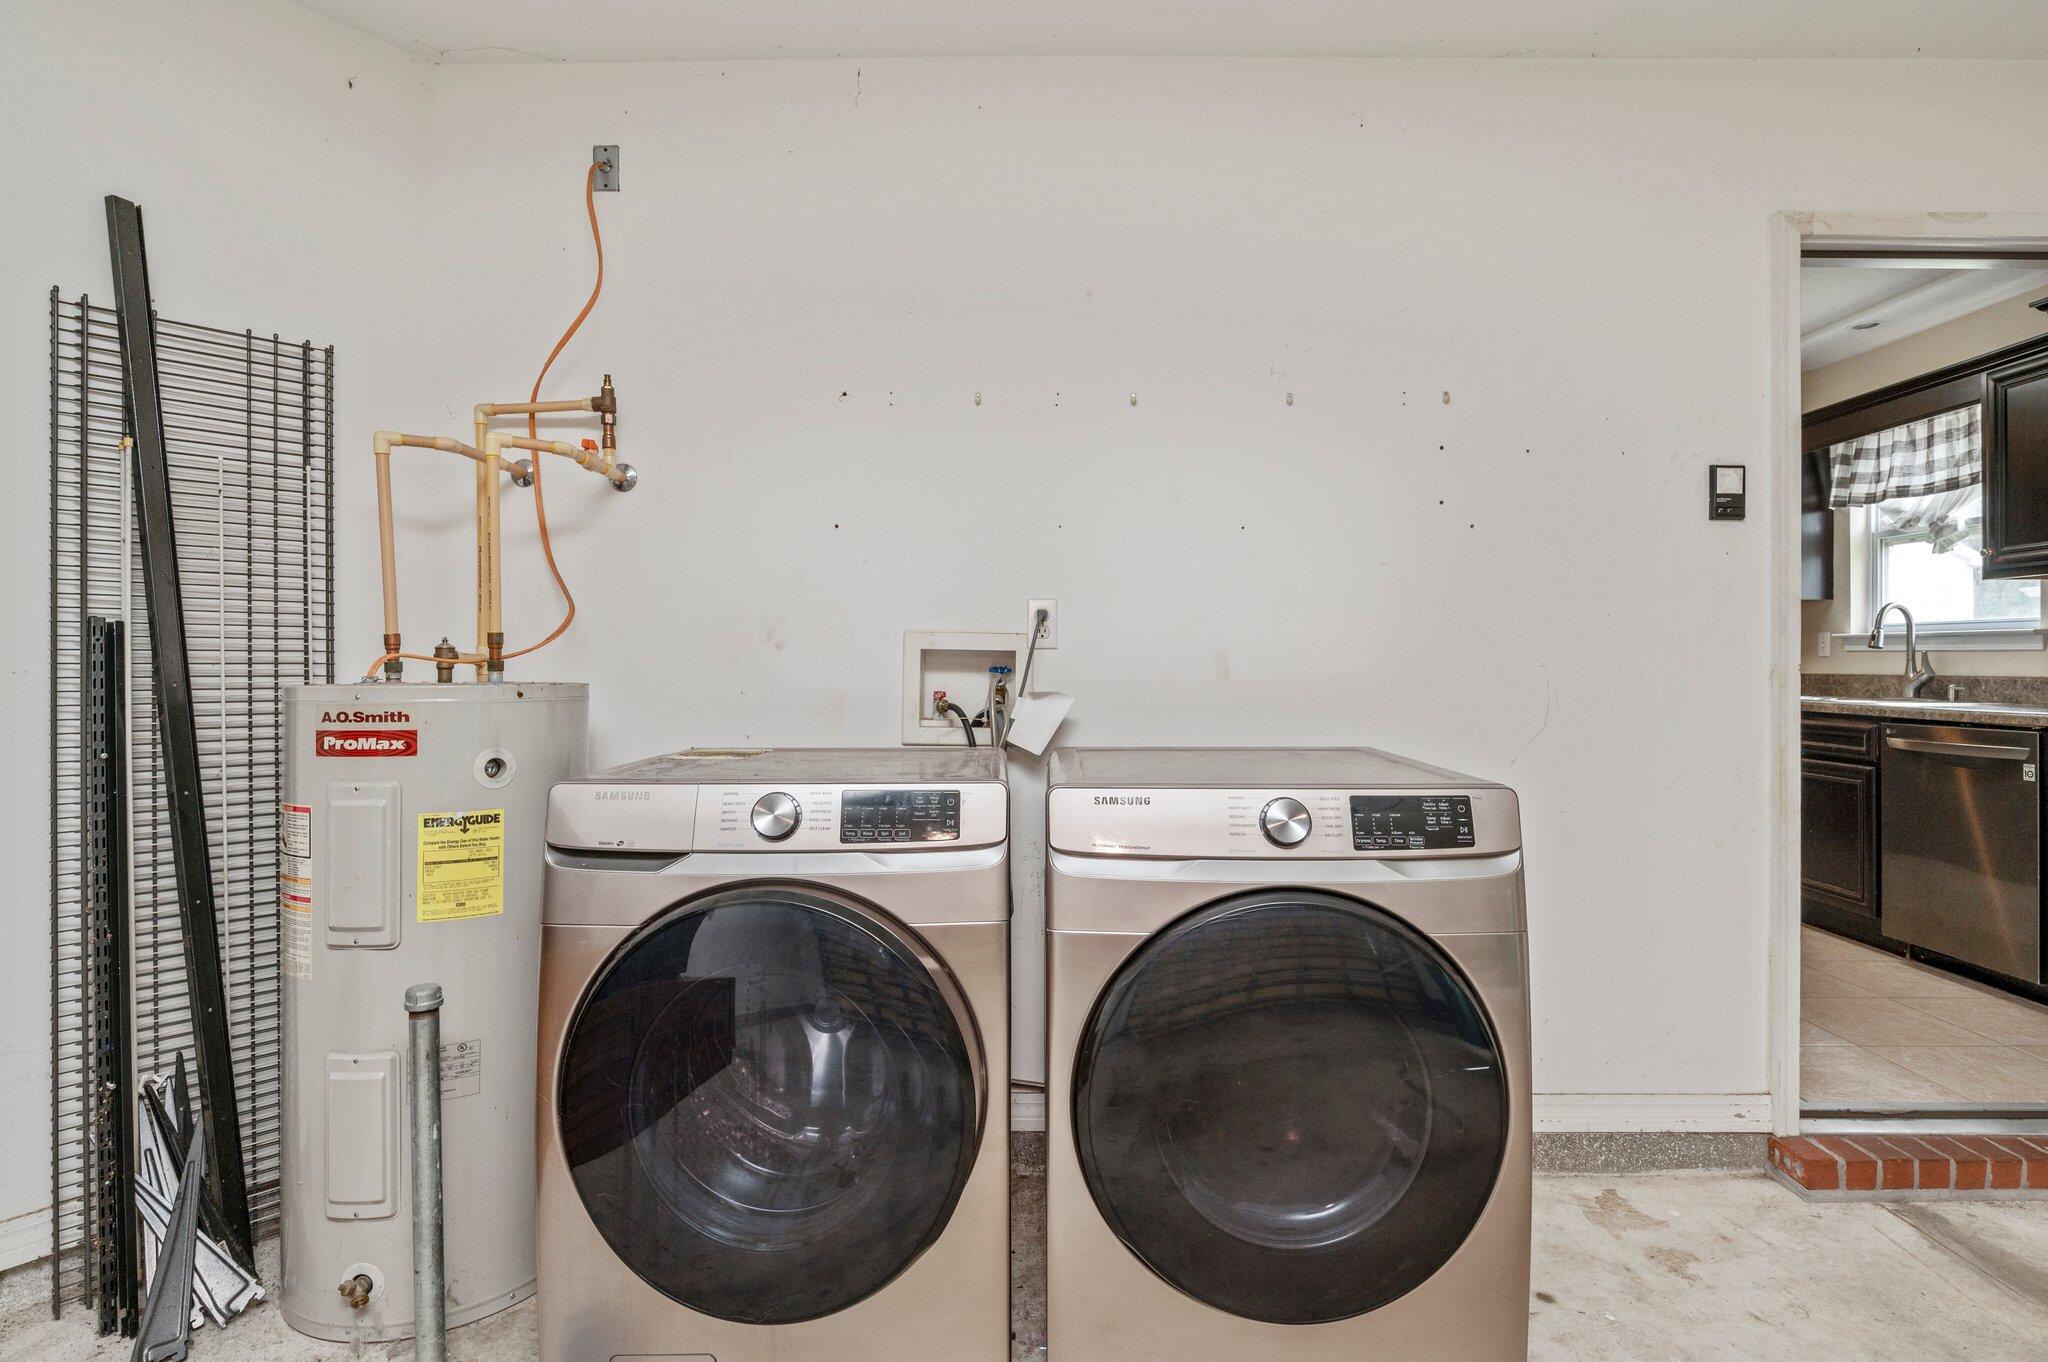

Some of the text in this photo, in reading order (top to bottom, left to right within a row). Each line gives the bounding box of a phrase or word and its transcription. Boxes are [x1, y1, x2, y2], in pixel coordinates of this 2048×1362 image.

[321, 711, 410, 723] A.O.Smith
[323, 736, 406, 750] ProMax
[594, 791, 650, 800] SAMSUNG
[1094, 796, 1151, 805] SAMSUNG
